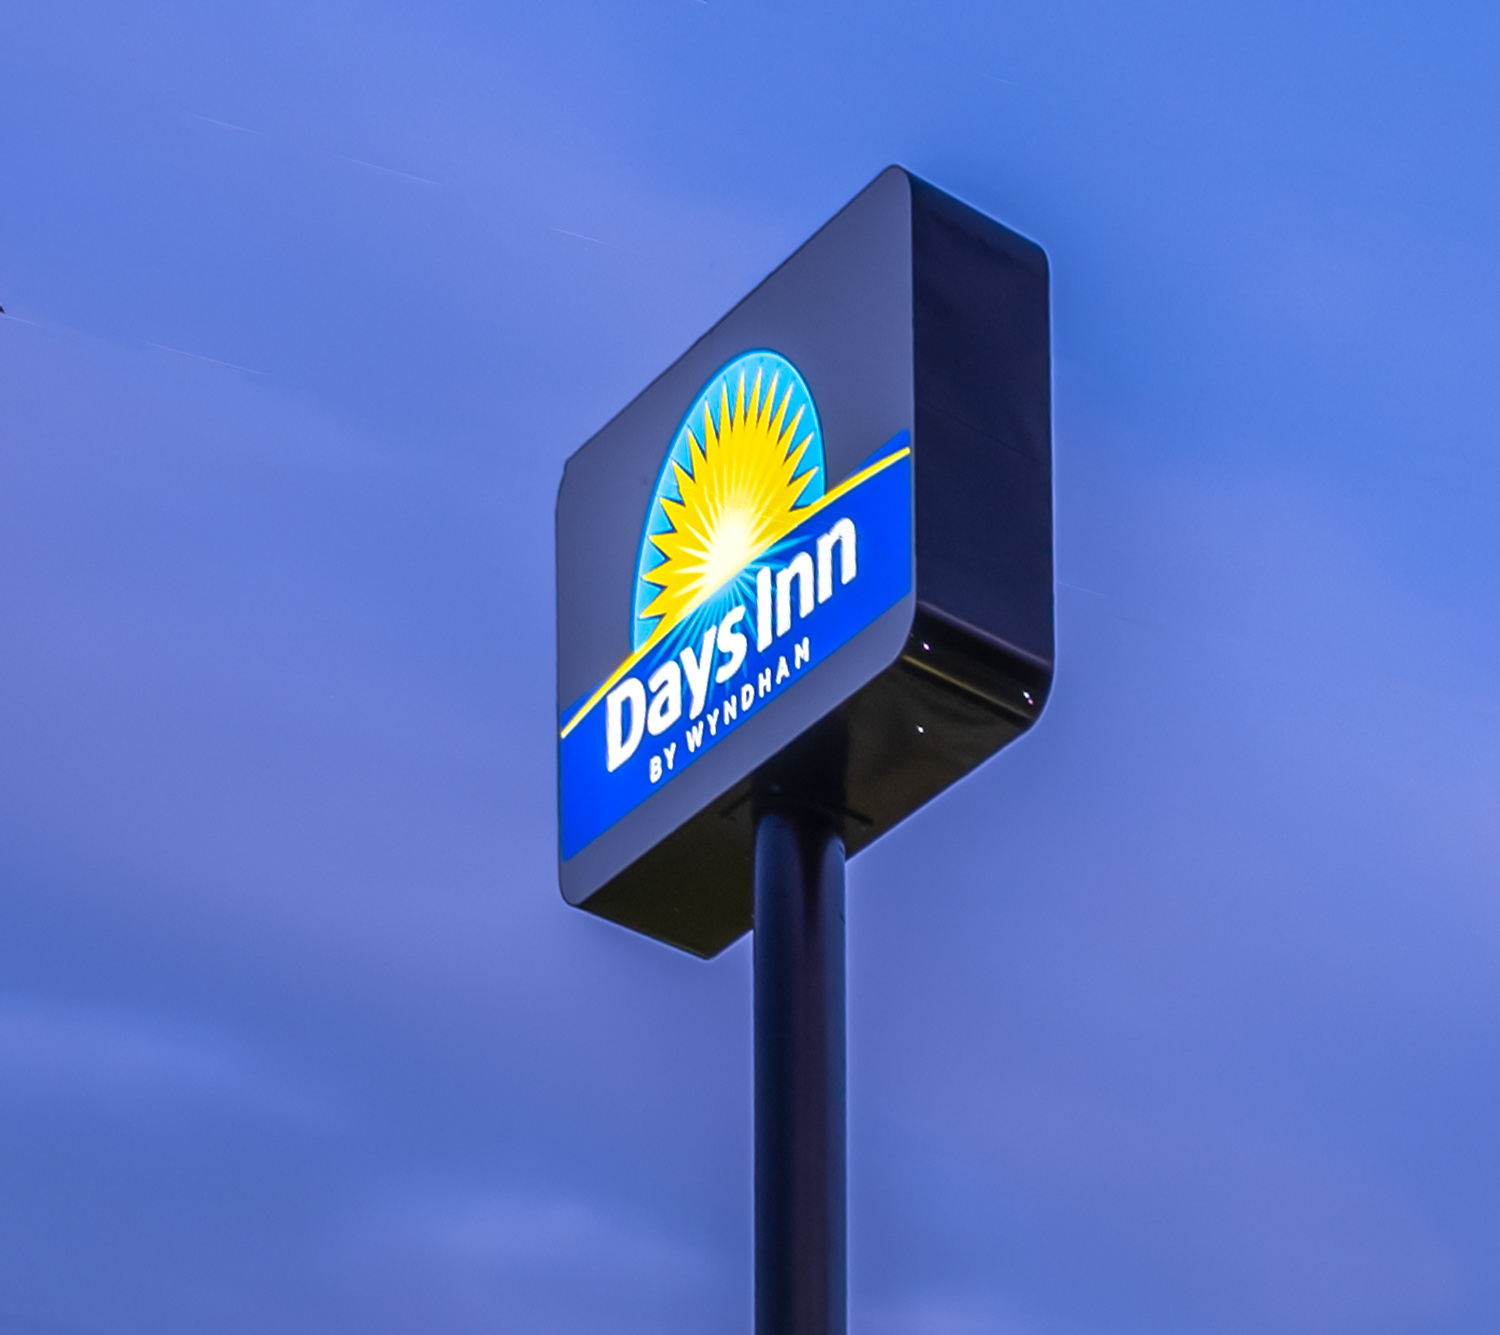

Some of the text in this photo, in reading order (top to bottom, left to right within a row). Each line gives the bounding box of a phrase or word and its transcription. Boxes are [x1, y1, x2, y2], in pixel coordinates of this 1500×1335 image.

[606, 517, 857, 773] Days Inn
[649, 742, 677, 784] BY
